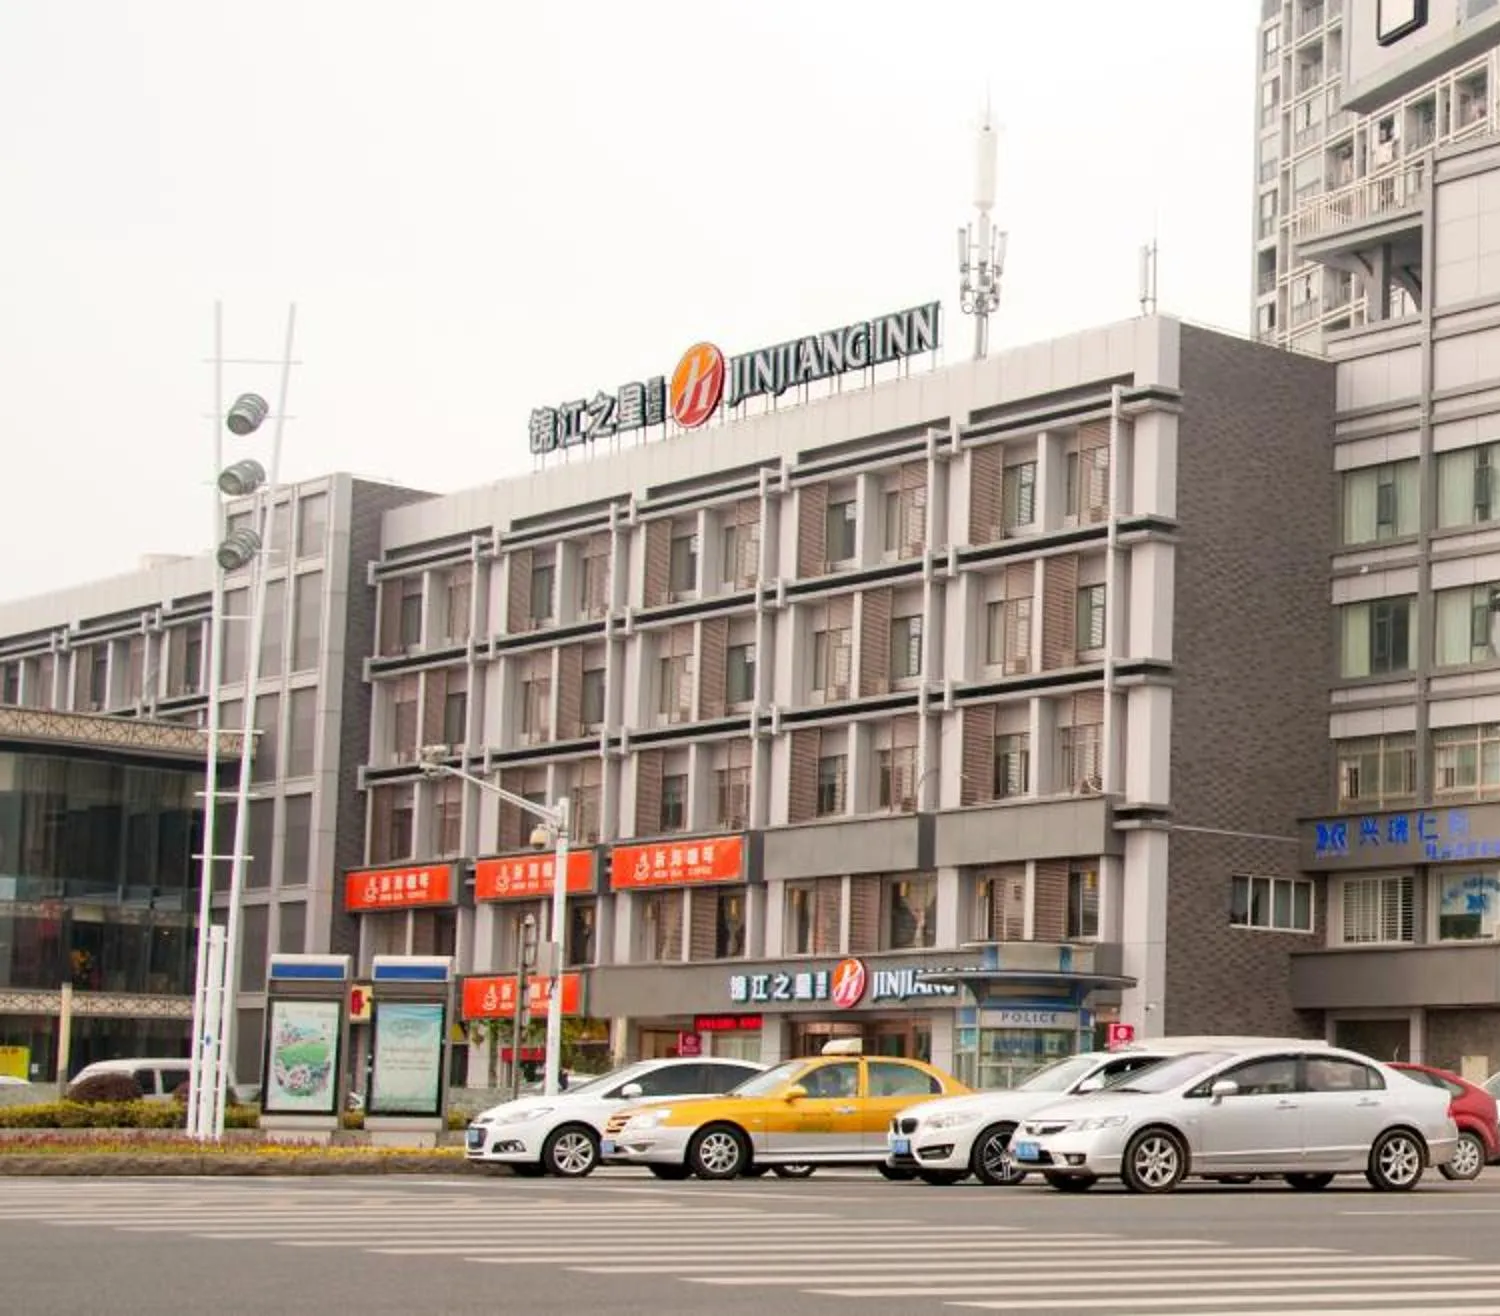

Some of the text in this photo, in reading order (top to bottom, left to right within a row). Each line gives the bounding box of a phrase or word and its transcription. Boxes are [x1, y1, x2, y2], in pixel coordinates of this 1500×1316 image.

[728, 300, 941, 408] JINJIANG INN
[529, 380, 646, 454] 锦江之星
[730, 972, 813, 1001] 锦江之星
[1001, 1010, 1057, 1024] POLICE
